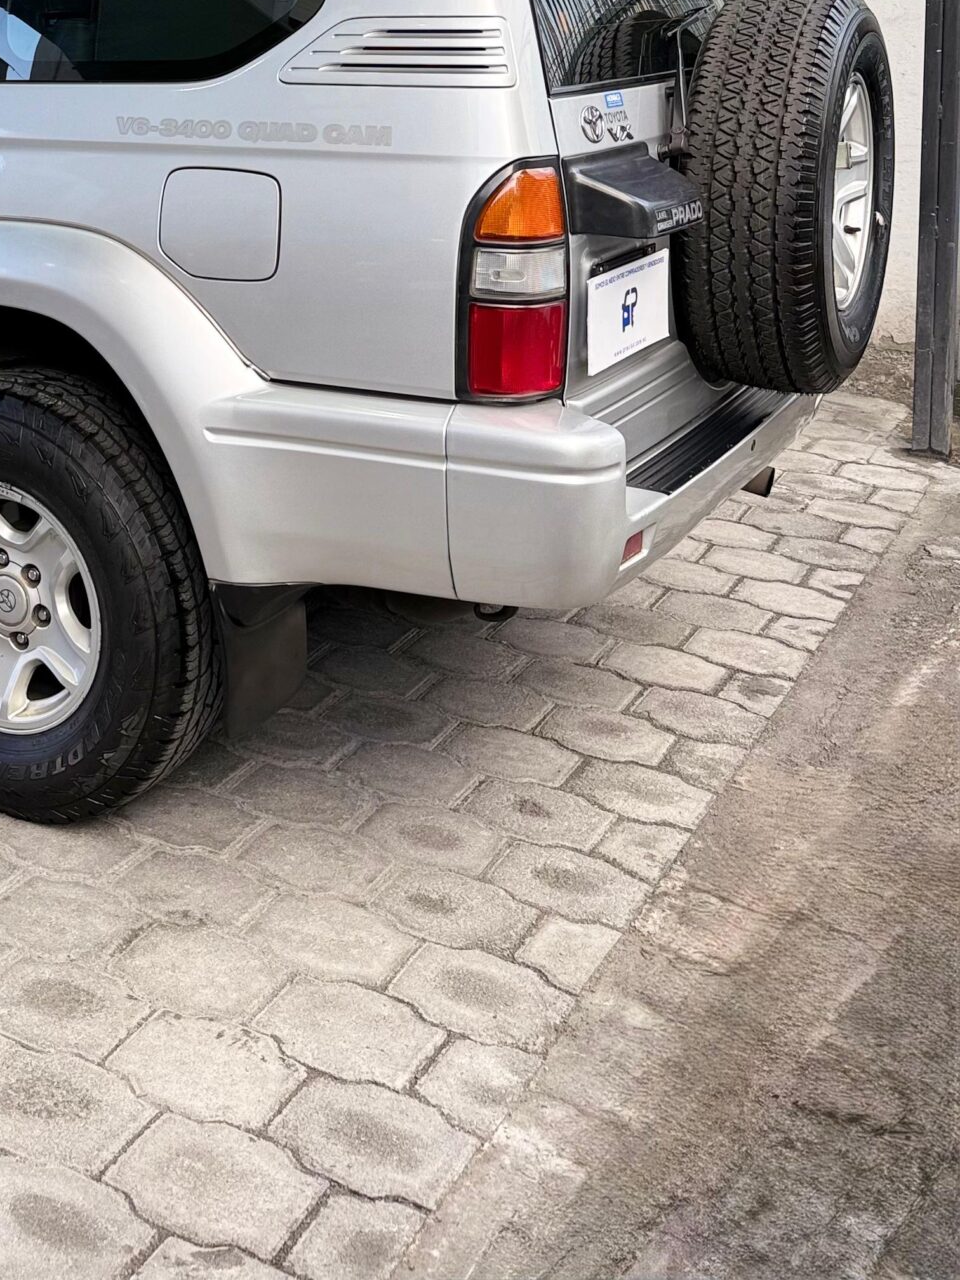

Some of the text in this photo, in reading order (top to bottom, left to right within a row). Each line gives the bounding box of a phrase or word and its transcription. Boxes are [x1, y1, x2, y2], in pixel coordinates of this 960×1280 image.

[604, 110, 629, 124] TOYOTA
[116, 116, 393, 146] V6-3400 QUAD CAM
[607, 124, 634, 142] VX
[671, 200, 703, 227] PRADO
